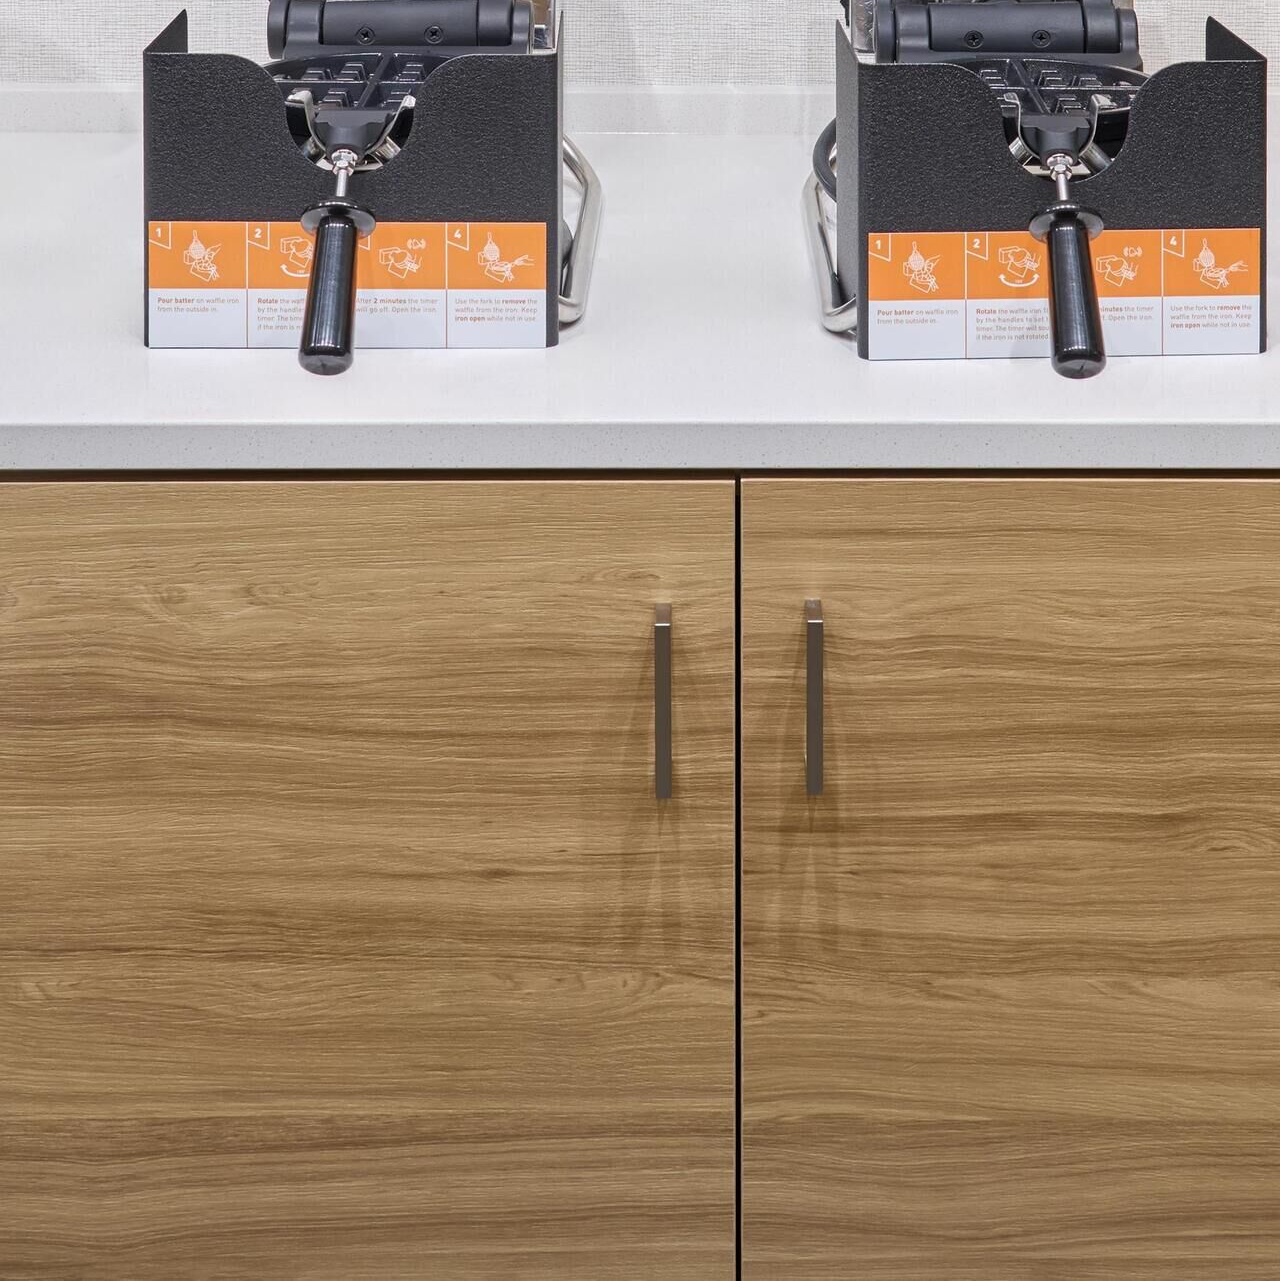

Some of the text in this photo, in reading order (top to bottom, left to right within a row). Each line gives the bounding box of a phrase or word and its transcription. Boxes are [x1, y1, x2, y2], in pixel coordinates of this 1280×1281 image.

[156, 228, 161, 237] 1
[255, 229, 261, 238] 2
[454, 229, 461, 239] 4
[876, 240, 881, 249] 1
[973, 239, 980, 248] 2
[1170, 237, 1177, 245] 4
